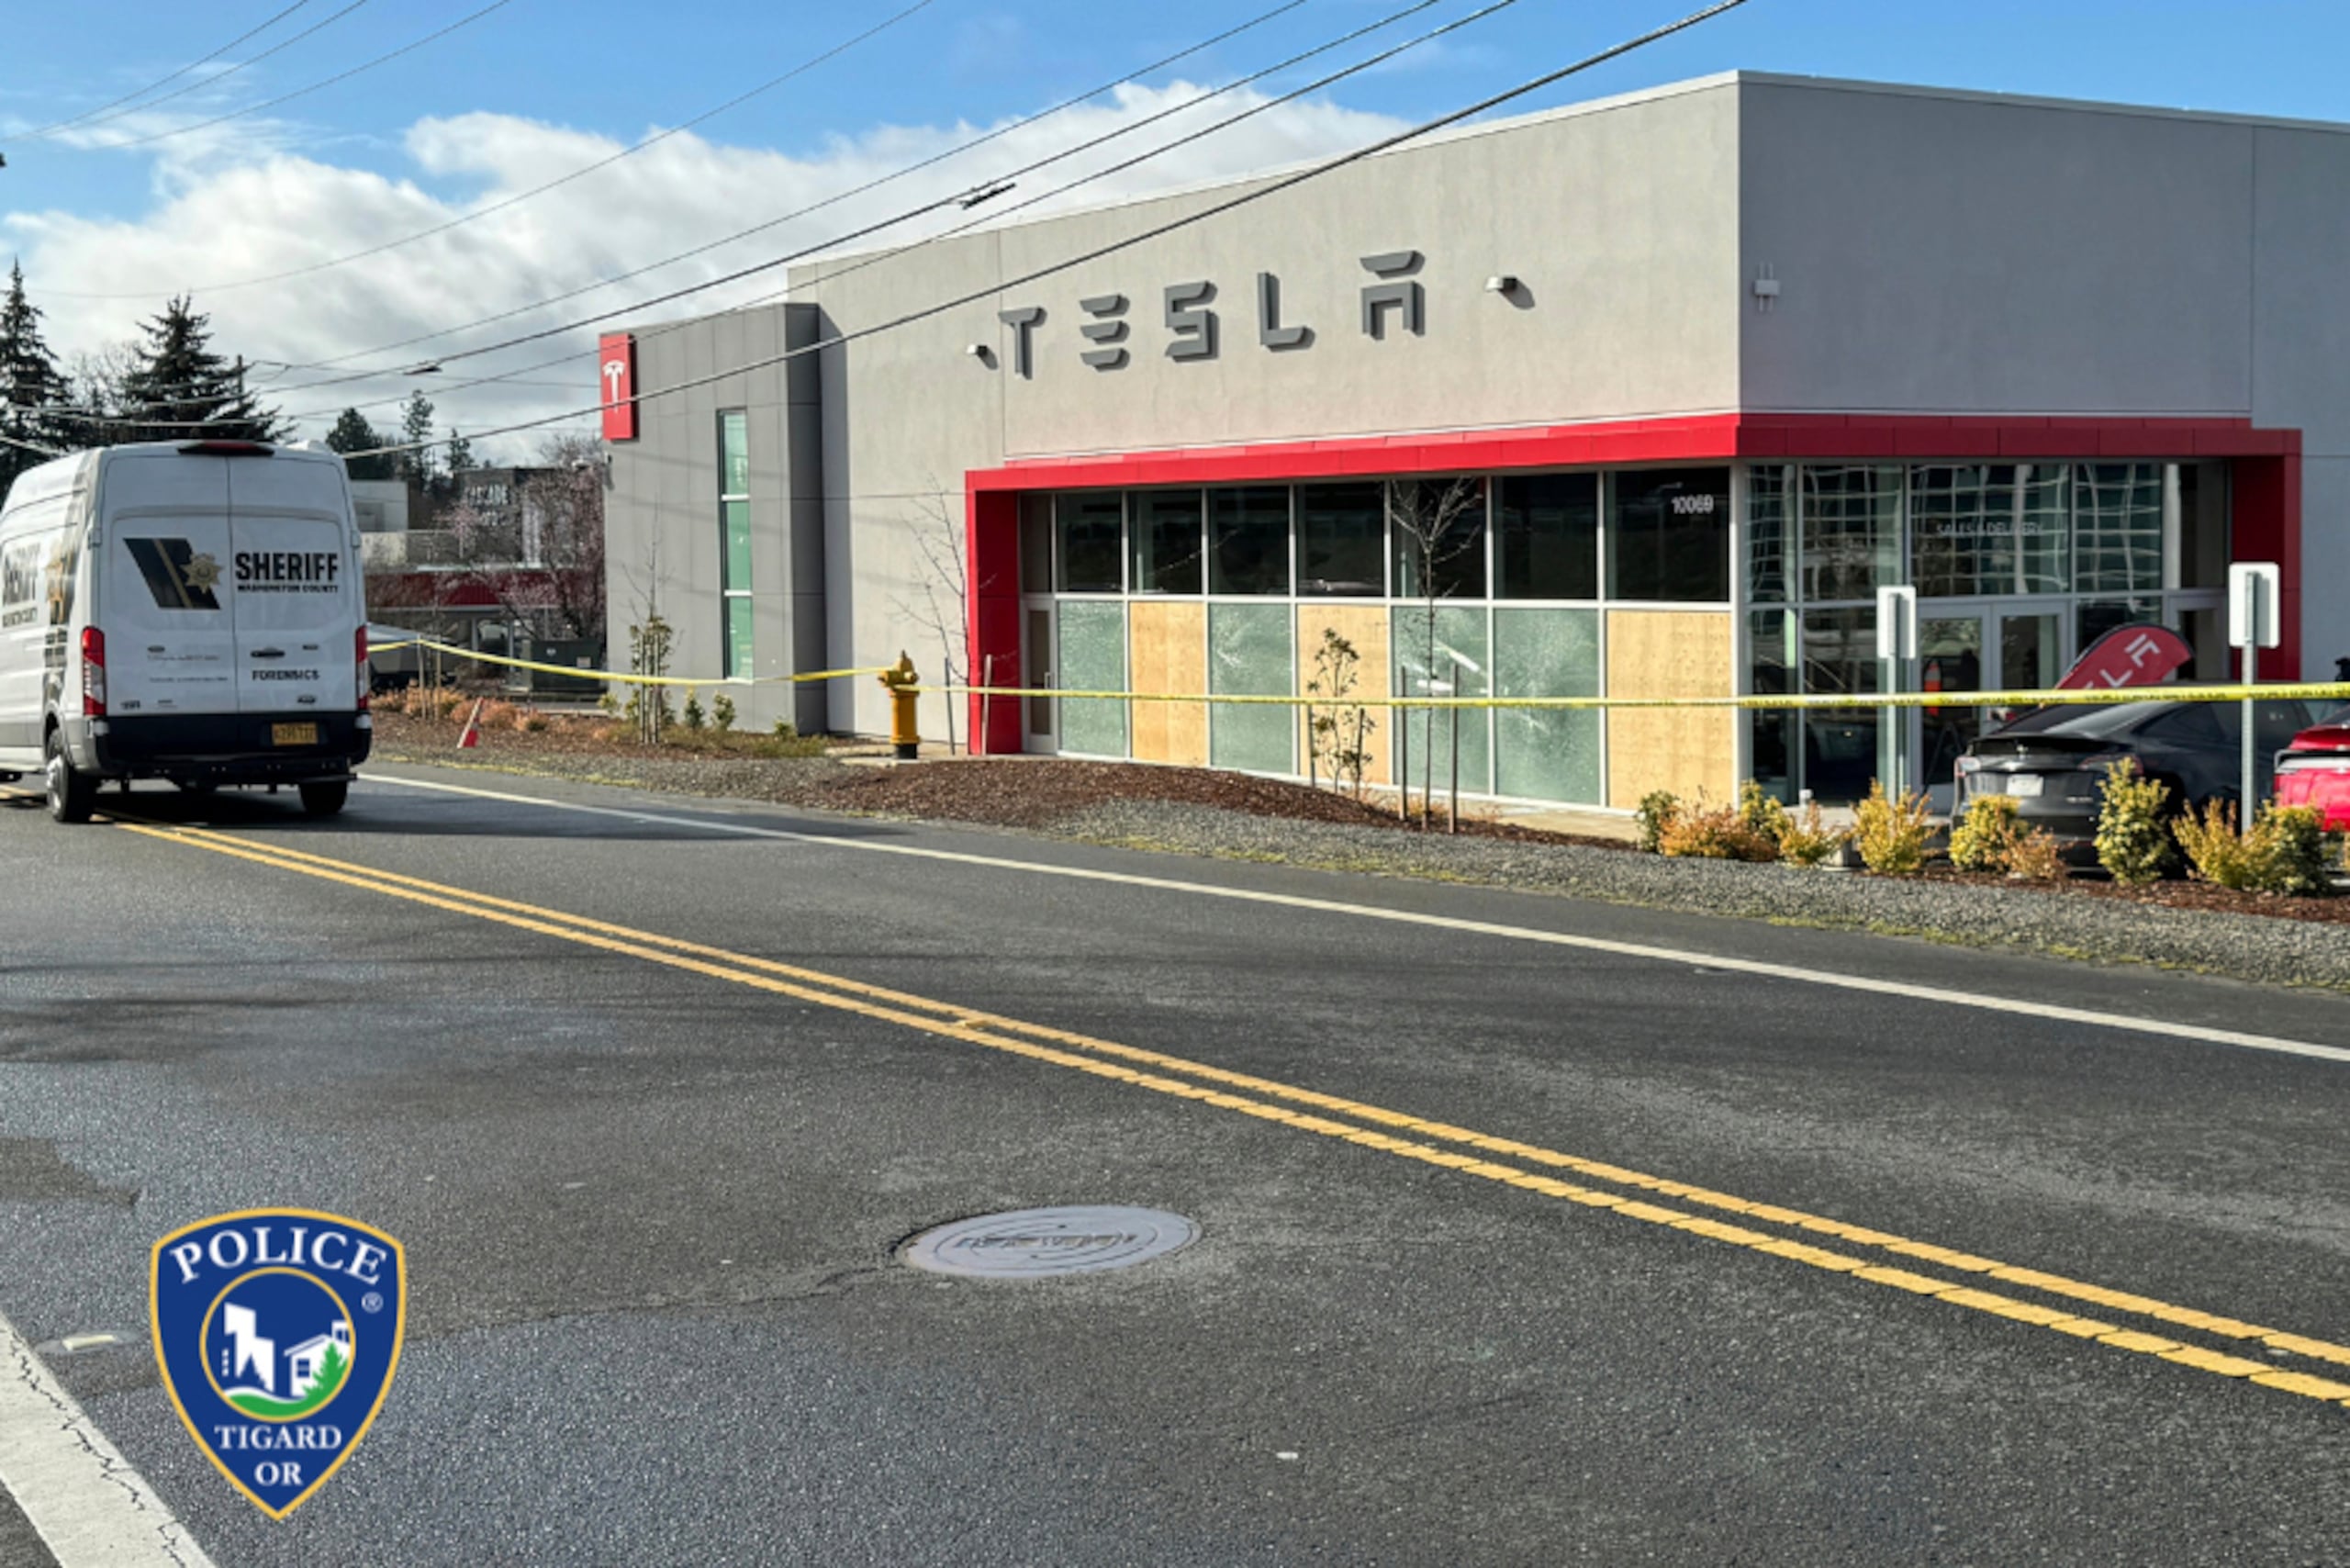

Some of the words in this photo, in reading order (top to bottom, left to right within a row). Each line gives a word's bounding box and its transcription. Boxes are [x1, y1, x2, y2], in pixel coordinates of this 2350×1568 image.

[998, 249, 1423, 377] TESLA
[1986, 521, 2043, 536] DELERY
[235, 552, 339, 581] SHERIFF
[302, 584, 339, 593] COUNTY
[252, 668, 320, 681] FORENSICS
